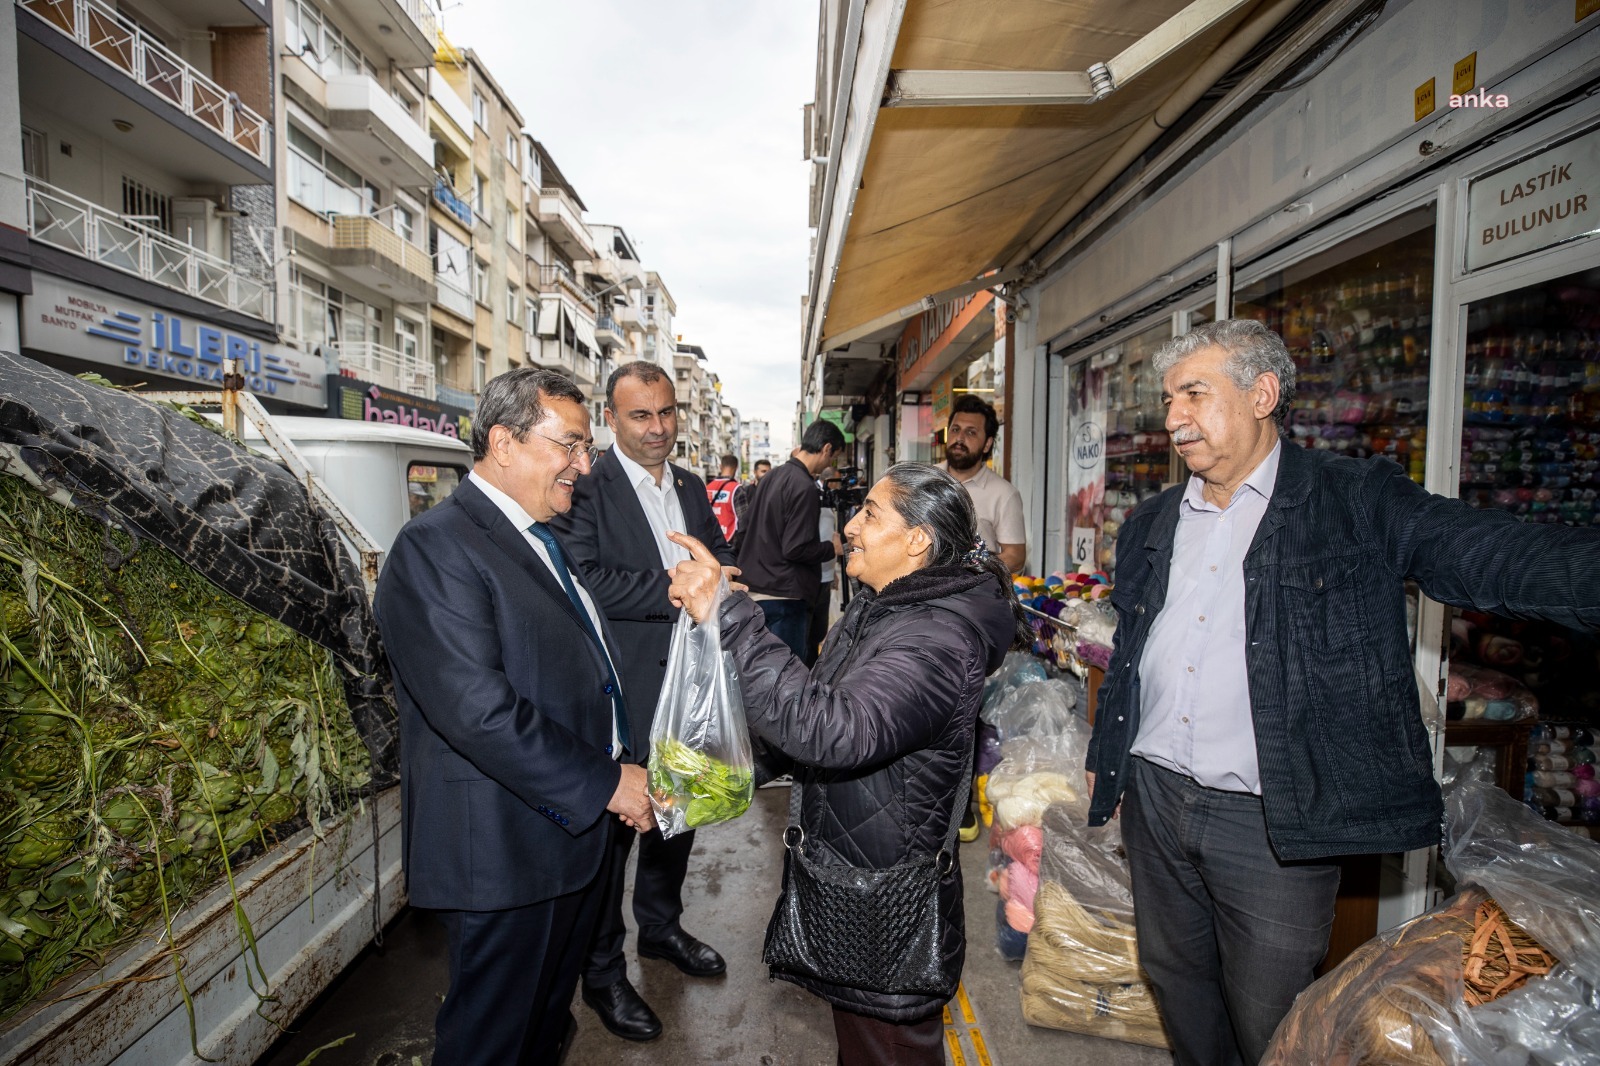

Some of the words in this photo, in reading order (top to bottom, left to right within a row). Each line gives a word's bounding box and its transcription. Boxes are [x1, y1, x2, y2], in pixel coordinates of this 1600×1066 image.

[1500, 162, 1573, 206] LASTİK
[1482, 194, 1588, 246] BULUNUR
[41, 313, 77, 330] BANYO
[55, 304, 94, 322] MUTFAK
[1077, 443, 1099, 460] NAKO
